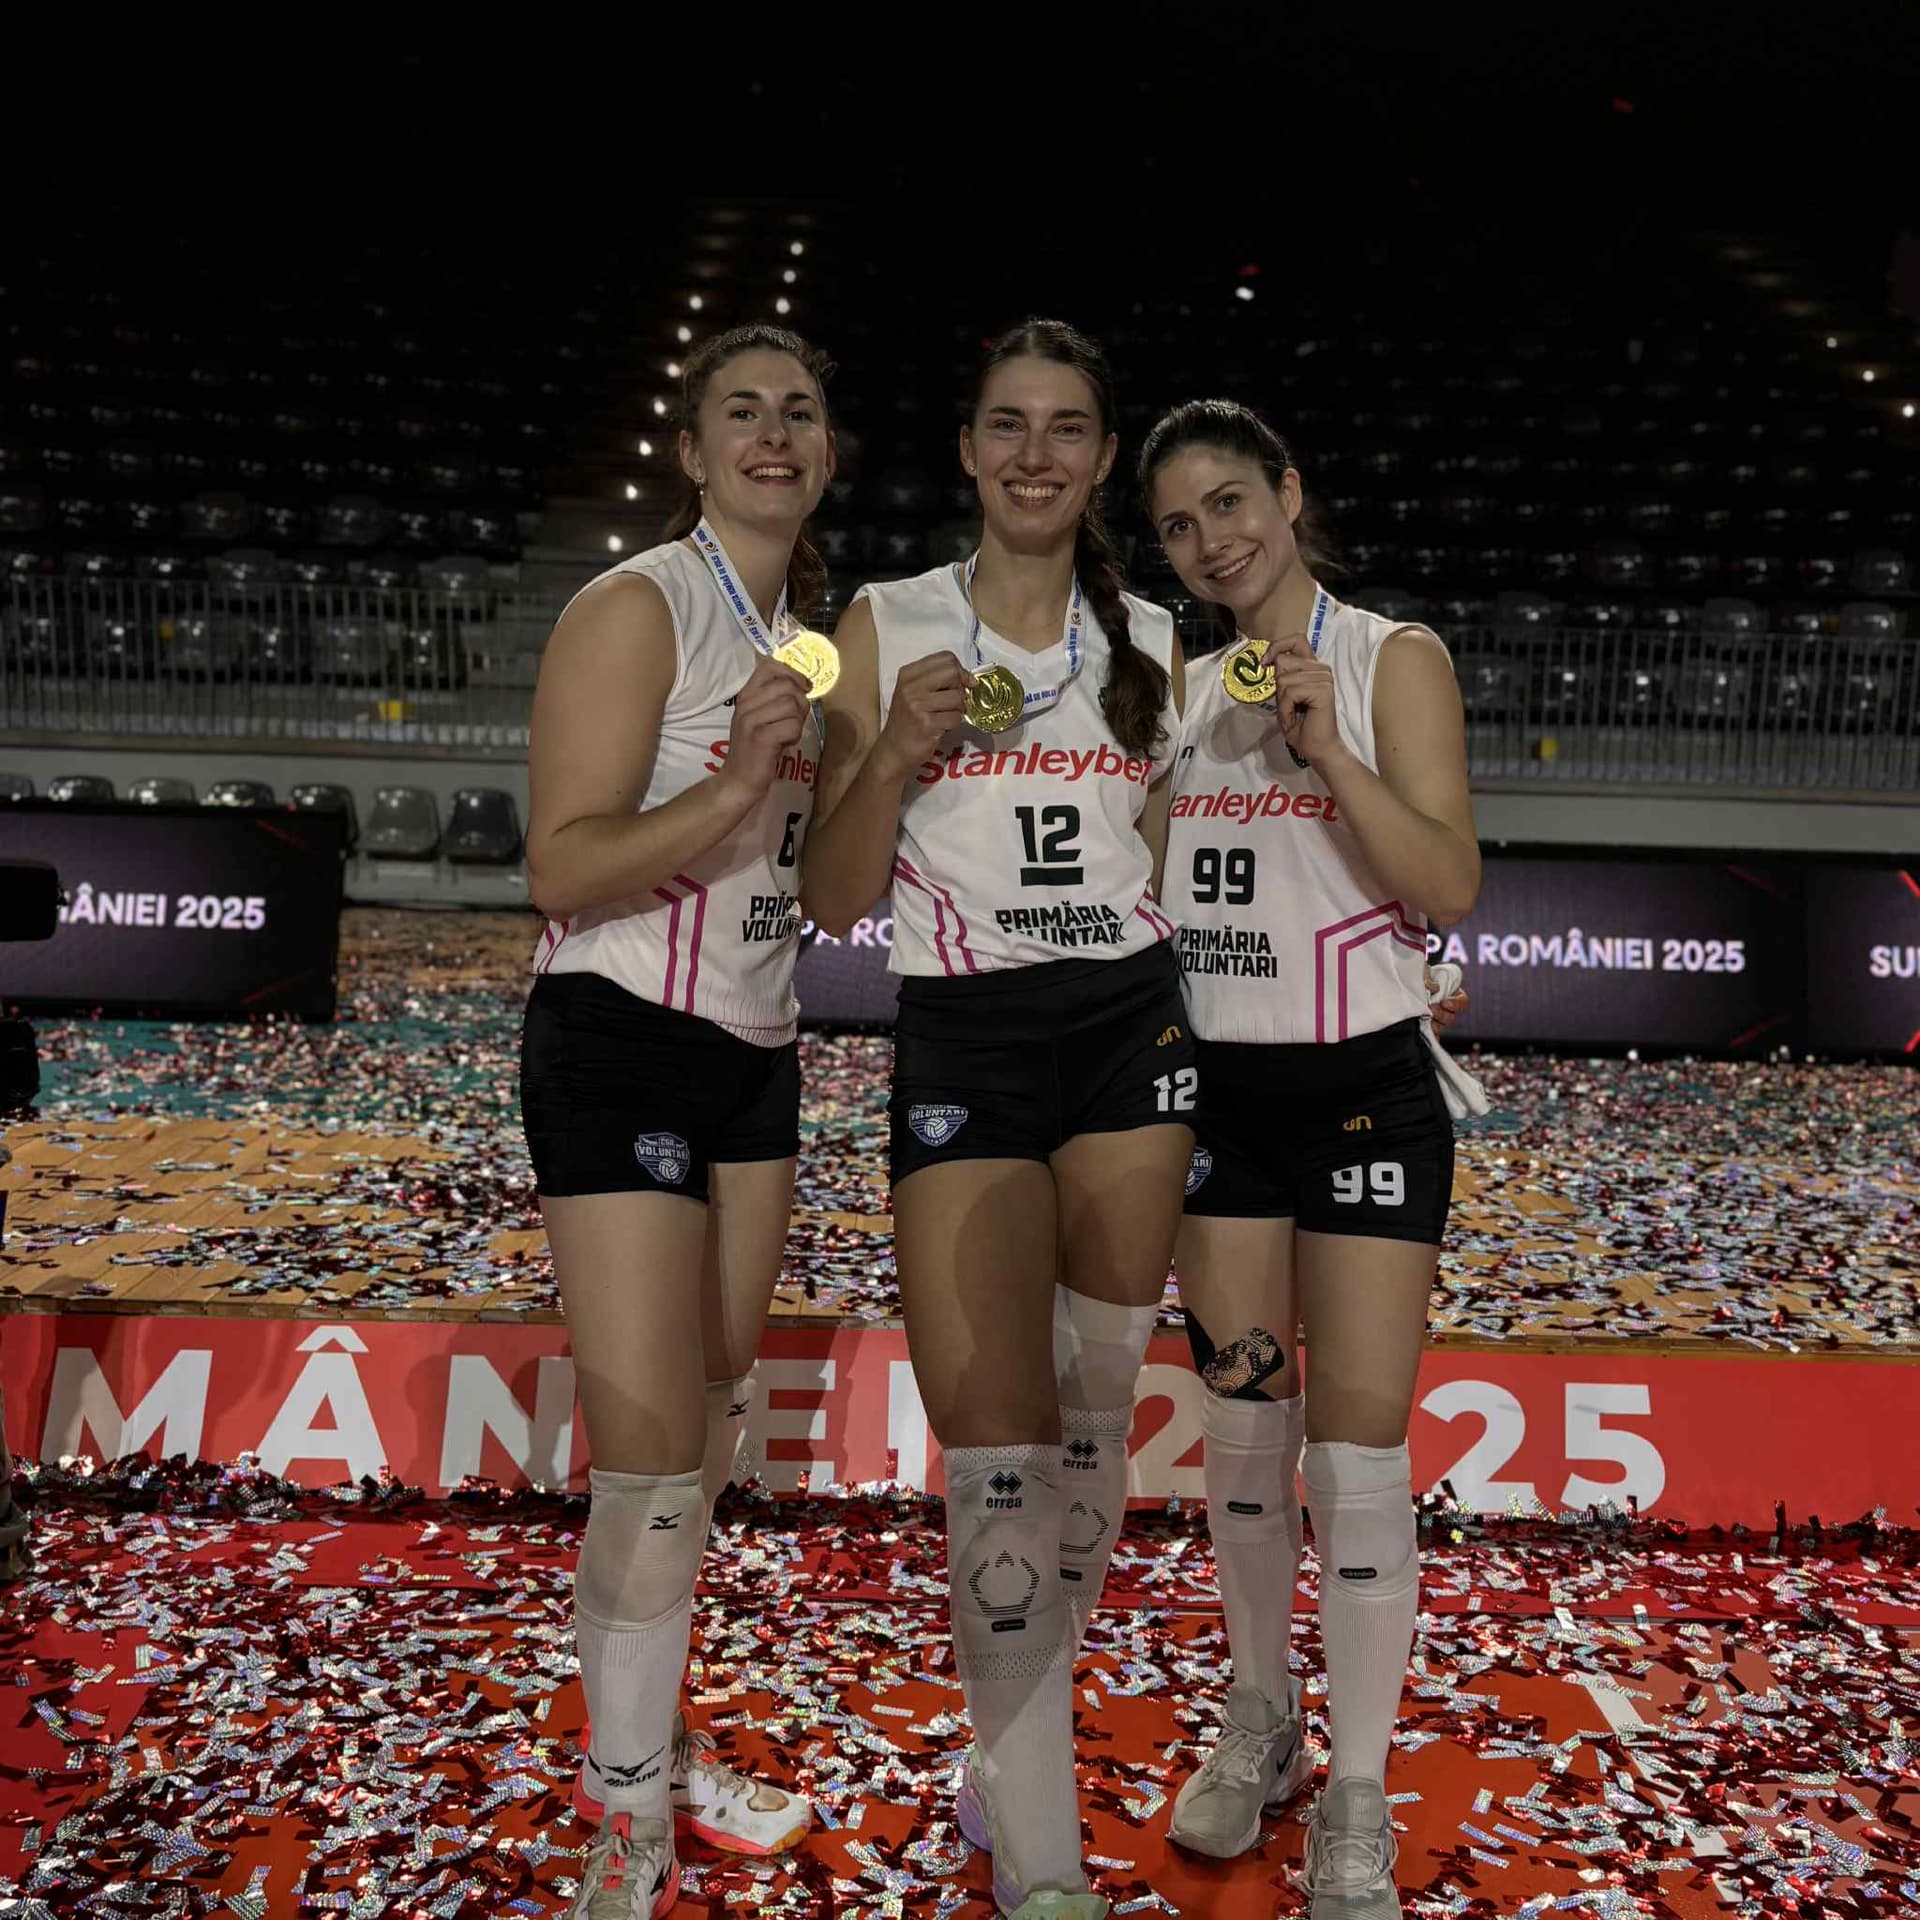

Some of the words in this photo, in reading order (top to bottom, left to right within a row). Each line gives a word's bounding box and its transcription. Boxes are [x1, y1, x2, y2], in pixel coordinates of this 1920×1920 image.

[916, 742, 1153, 785] Stanleybet
[1171, 784, 1339, 824] anleybet
[1015, 805, 1082, 863] 12
[1192, 848, 1255, 905] 99
[58, 881, 167, 927] ÂNIEI
[174, 894, 267, 931] 2025
[994, 900, 1120, 931] PRIMĂRIA
[1179, 924, 1272, 955] PRIMĂRIA
[1477, 926, 1654, 971] ROMÂNIEI
[1661, 940, 1746, 974] 2025
[1869, 944, 1920, 979] SU
[1176, 949, 1278, 979] VOLUNTARI
[1153, 1066, 1198, 1112] 12
[1331, 1161, 1405, 1207] 99
